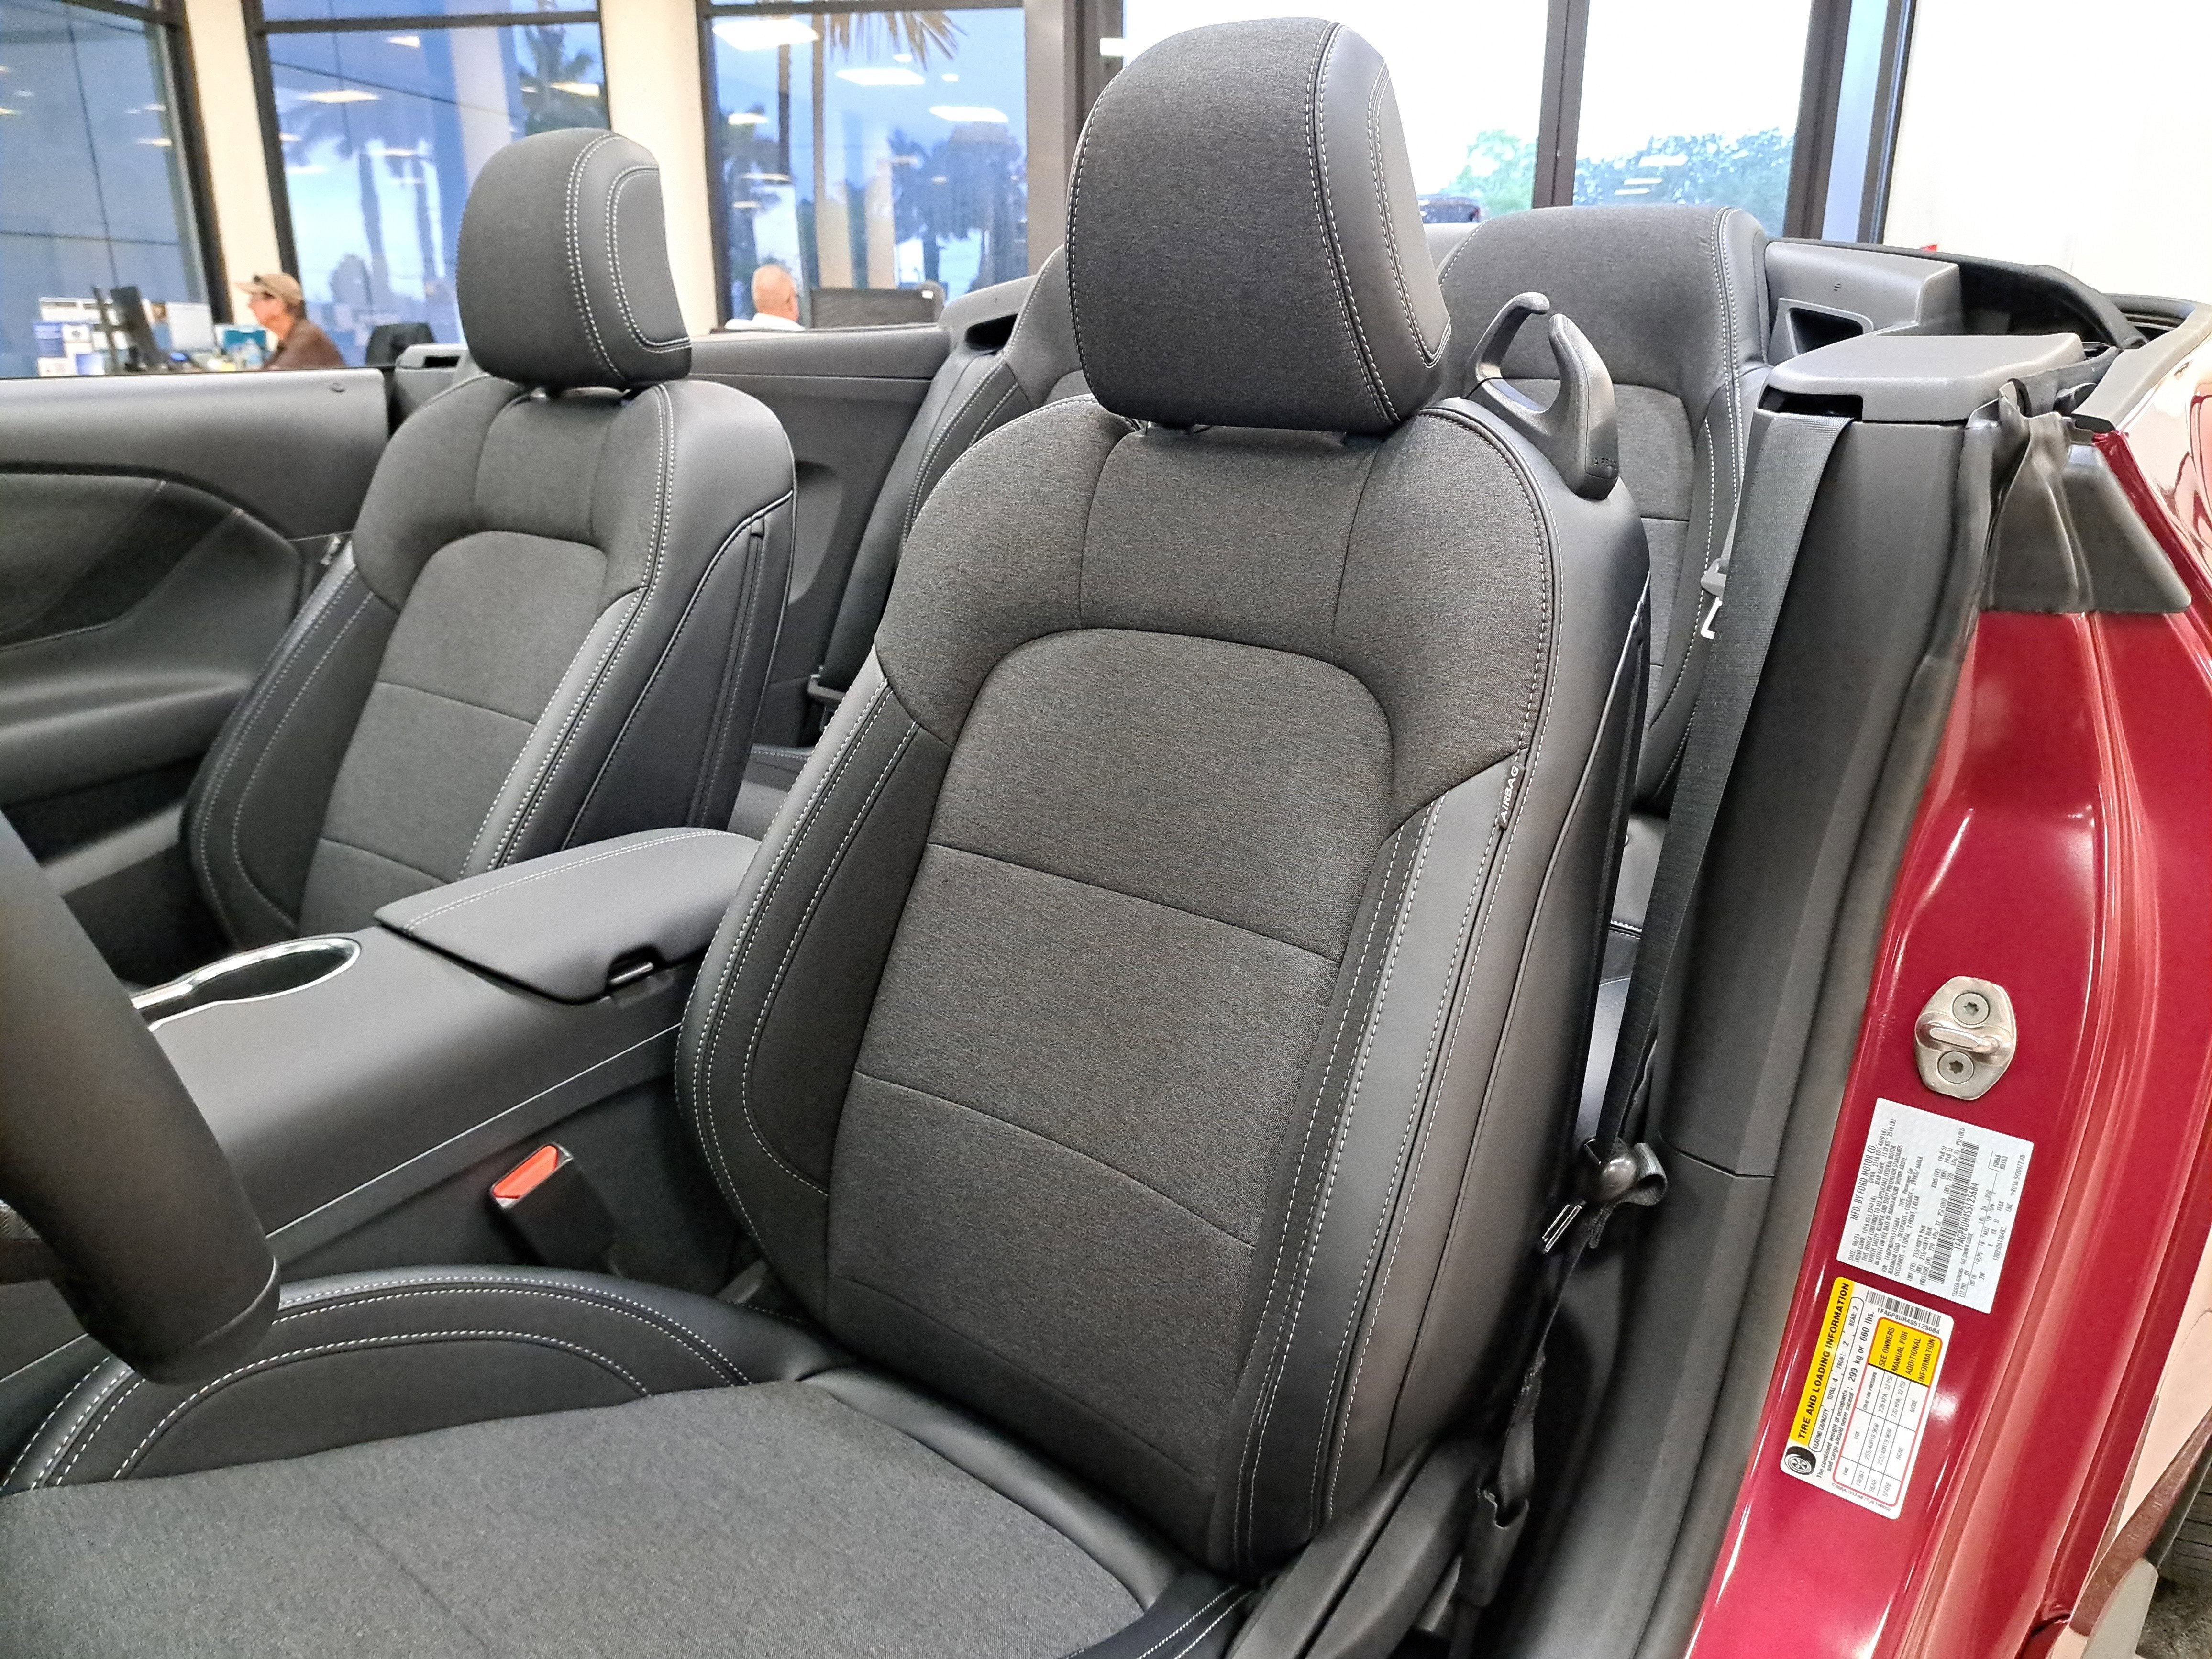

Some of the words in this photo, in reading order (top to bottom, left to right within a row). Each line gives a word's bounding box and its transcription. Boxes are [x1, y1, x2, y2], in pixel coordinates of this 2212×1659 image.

[1500, 765, 1519, 823] AIRBAG
[1867, 1142, 1877, 1154] CO.
[1887, 1144, 1896, 1160] MOTOR
[1860, 1154, 1874, 1176] MOTOR
[1883, 1160, 1892, 1176] FEDERAL
[1856, 1177, 1868, 1194] FORD
[1877, 1177, 1888, 1200] APPLICABLE
[1854, 1194, 1863, 1204] BY
[1849, 1204, 1861, 1220] MFD.
[1868, 1213, 1879, 1236] CONFORMS
[1864, 1236, 1873, 1251] VEHICLE
[1868, 1247, 1877, 1263] VEHICLE
[1894, 1253, 1904, 1277] OCCUPANTS
[1864, 1310, 1874, 1324] lbs.
[1859, 1326, 1870, 1342] 660
[1881, 1326, 1895, 1353] OWNERS
[1857, 1345, 1864, 1354] or
[1891, 1345, 1904, 1372] MANUAL
[1899, 1330, 1908, 1344] FOR
[1904, 1336, 1921, 1375] ADDITIONAL
[1797, 1416, 1811, 1440] TIRE
[1804, 1394, 1817, 1416] AND
[1811, 1349, 1830, 1393] LOADING
[1824, 1282, 1850, 1349] INFORMATION
[1853, 1354, 1863, 1365] kg
[1878, 1354, 1887, 1367] SEE
[1917, 1338, 1935, 1382] INFORMATION
[1847, 1366, 1858, 1382] 299
[1835, 1389, 1848, 1416] occupants
[1844, 1391, 1854, 1411] exceed
[1909, 1399, 1917, 1413] NONE
[1839, 1411, 1848, 1426] never
[1812, 1430, 1823, 1450] SEATING
[1818, 1407, 1829, 1431] CAPACITY
[1827, 1423, 1839, 1442] weight
[1834, 1426, 1844, 1445] should
[1820, 1441, 1832, 1468] combined
[1830, 1445, 1839, 1461] cargo
[1895, 1446, 1904, 1460] NONE
[1817, 1467, 1825, 1479] The
[1856, 1470, 1865, 1486] FRONT
[1869, 1478, 1877, 1492] REAR
[1882, 1482, 1891, 1498] SPARE
